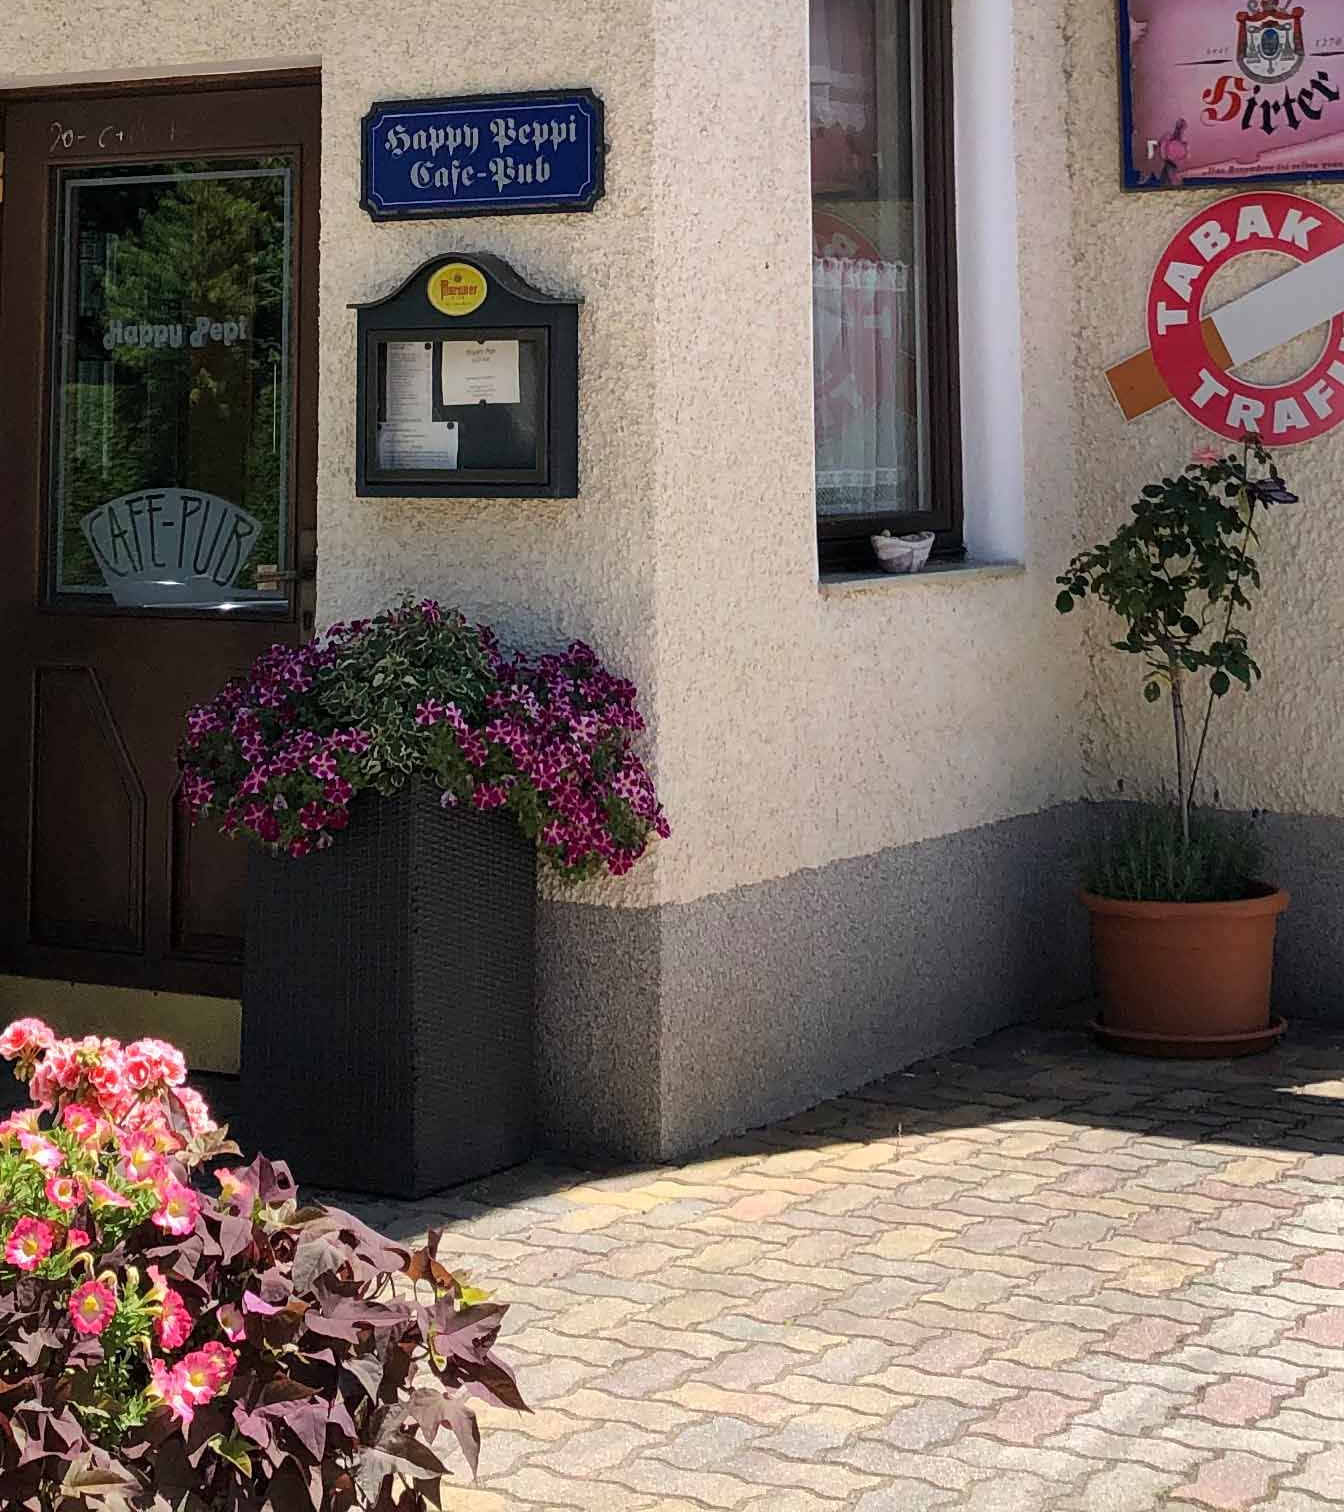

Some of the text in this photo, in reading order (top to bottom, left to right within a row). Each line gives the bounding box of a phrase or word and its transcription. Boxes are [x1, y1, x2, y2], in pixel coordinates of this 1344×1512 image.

[1200, 71, 1340, 136] Hirter
[385, 114, 577, 159] Happy Peppi
[410, 155, 551, 196] Cafe-Pub
[1157, 204, 1322, 336] TABAK
[102, 315, 250, 350] Happy Pepi
[89, 493, 255, 588] CAFE-PUB
